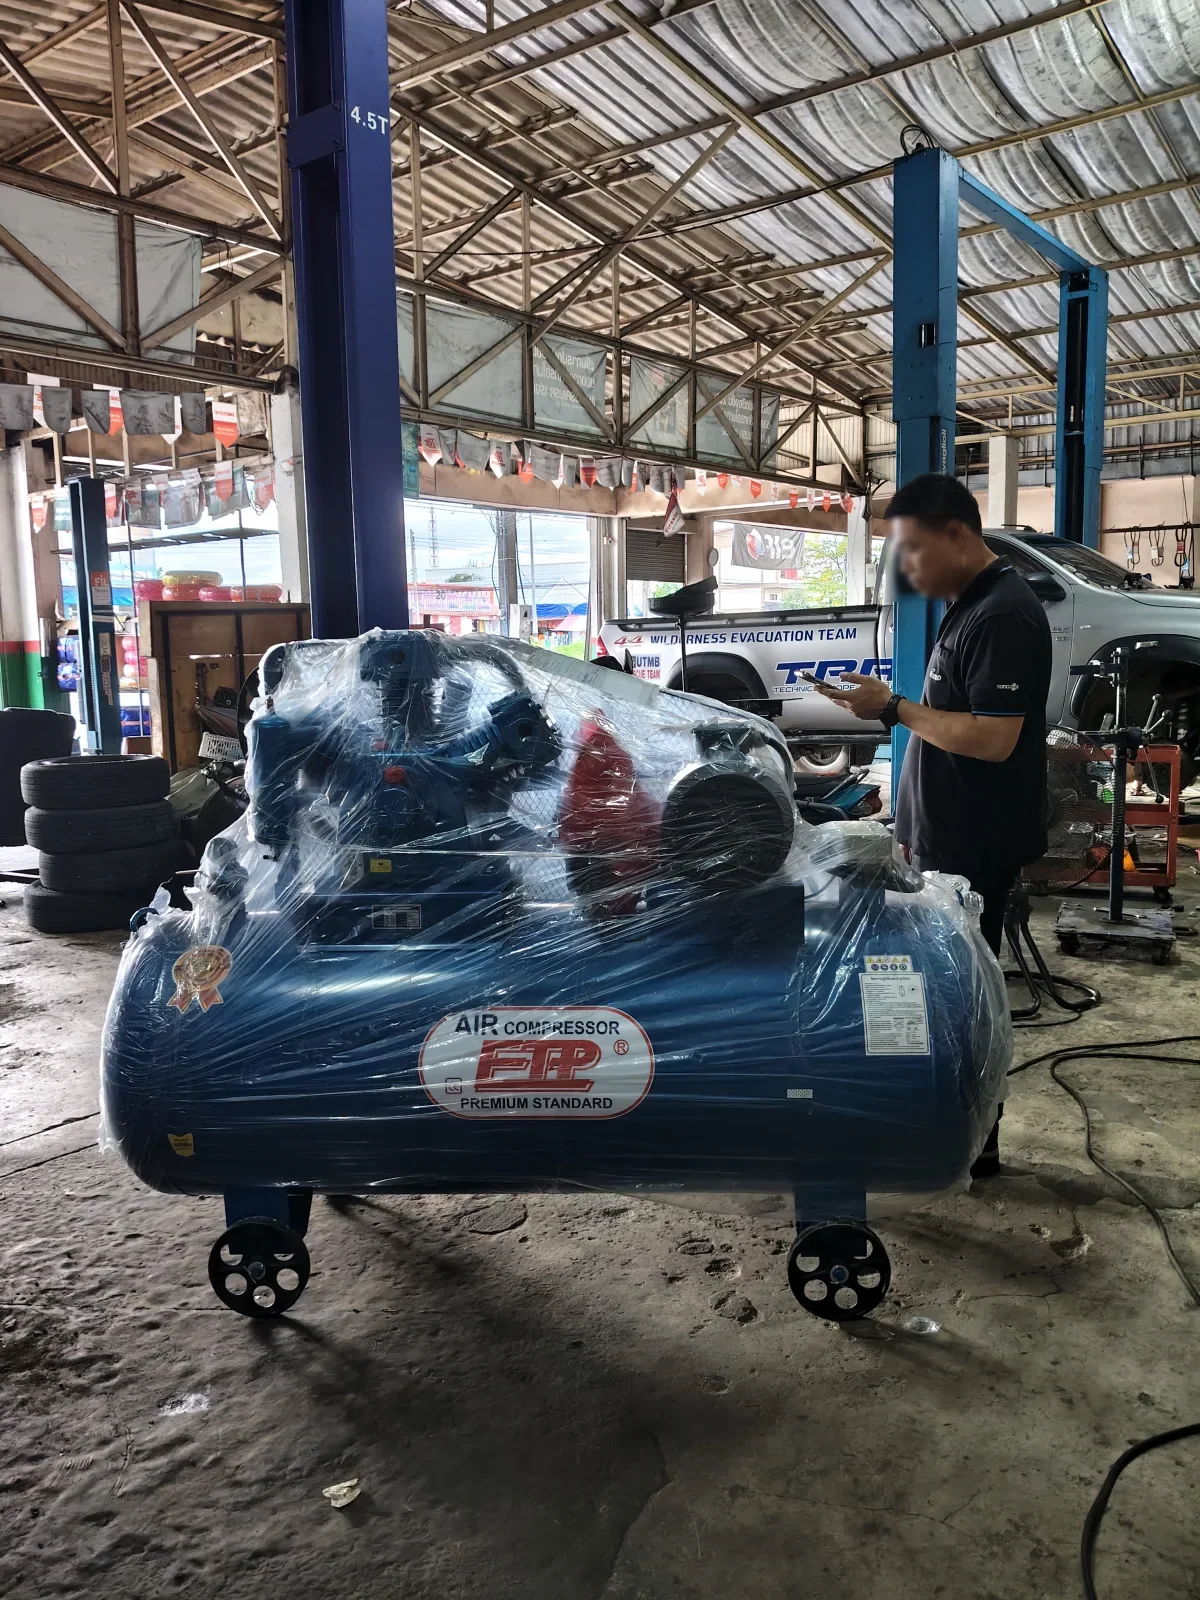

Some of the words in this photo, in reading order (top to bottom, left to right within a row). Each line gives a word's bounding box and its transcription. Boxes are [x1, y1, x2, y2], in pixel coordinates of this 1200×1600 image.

[350, 105, 389, 135] 4.5T
[650, 632, 727, 646] WILDRNESS
[730, 629, 814, 644] EVACUATION
[818, 627, 858, 641] TEAM
[636, 656, 661, 668] UTMB
[647, 669, 661, 679] TEAM
[773, 684, 813, 693] TECHNIC
[455, 1013, 498, 1036] AIR
[504, 1020, 620, 1035] COMPRESSOR
[460, 1097, 528, 1109] PREMIUM
[532, 1097, 613, 1109] STANDARD
